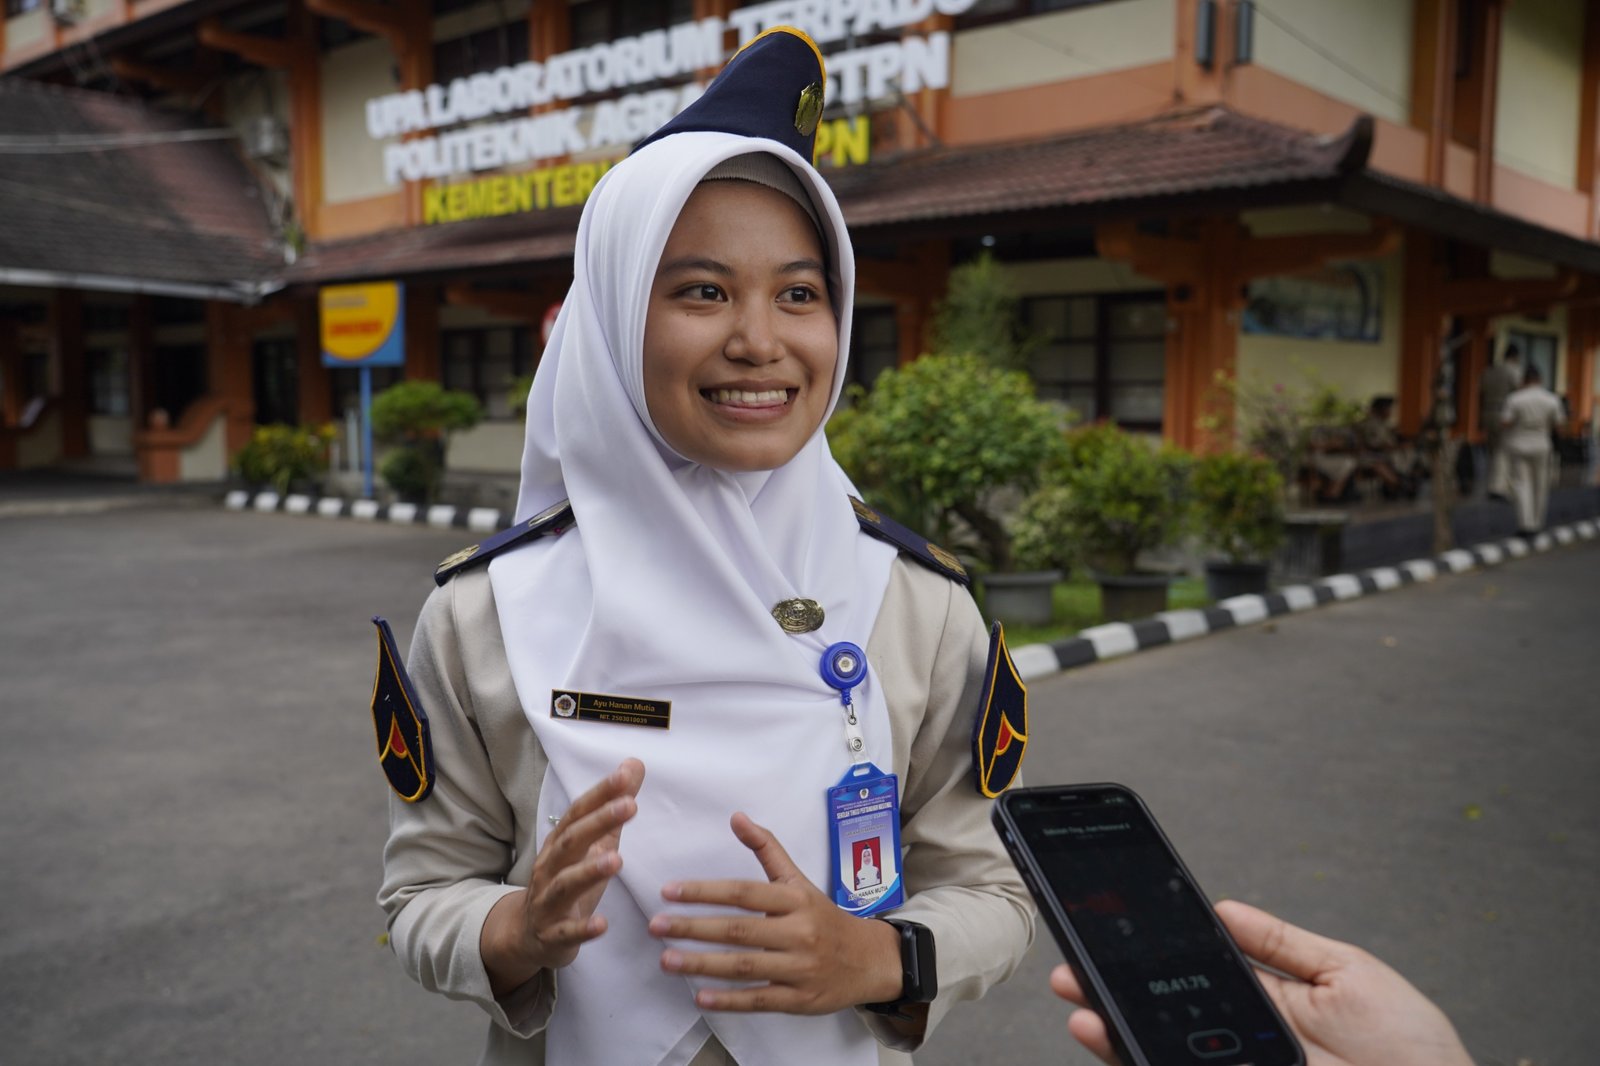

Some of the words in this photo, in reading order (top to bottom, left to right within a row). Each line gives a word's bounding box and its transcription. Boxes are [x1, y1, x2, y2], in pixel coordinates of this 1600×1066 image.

[427, 16, 722, 127] LABORATORIUM
[385, 106, 586, 186] POLITEKNIK
[593, 699, 608, 709] Ayu
[609, 701, 633, 710] Hanan
[634, 703, 656, 712] Mutia
[859, 889, 874, 898] HANAN
[874, 885, 889, 895] MUTIA
